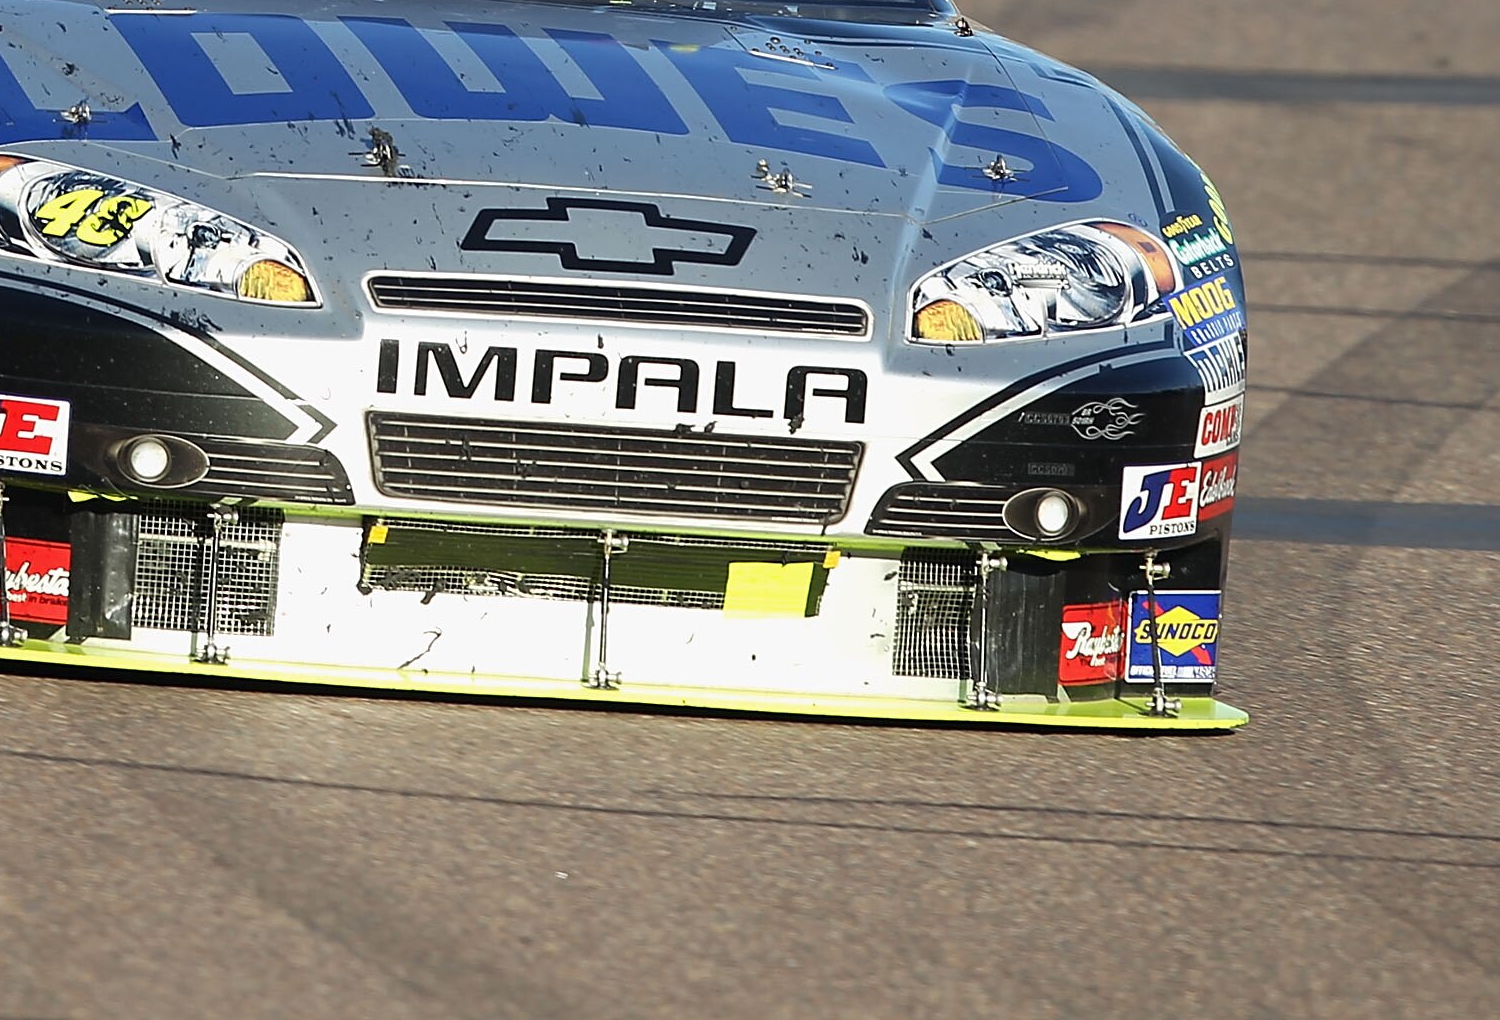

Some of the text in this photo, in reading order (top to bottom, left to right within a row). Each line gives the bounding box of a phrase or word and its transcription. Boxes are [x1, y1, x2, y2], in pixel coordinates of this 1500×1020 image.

[35, 188, 154, 248] 48
[1190, 254, 1234, 279] BELTS
[1169, 277, 1236, 330] MOOG
[376, 339, 868, 423] IMPALA
[1201, 404, 1237, 446] COMP
[1123, 466, 1199, 534] JE
[1149, 520, 1196, 536] PISTONS
[1140, 622, 1218, 640] SUNOCO
